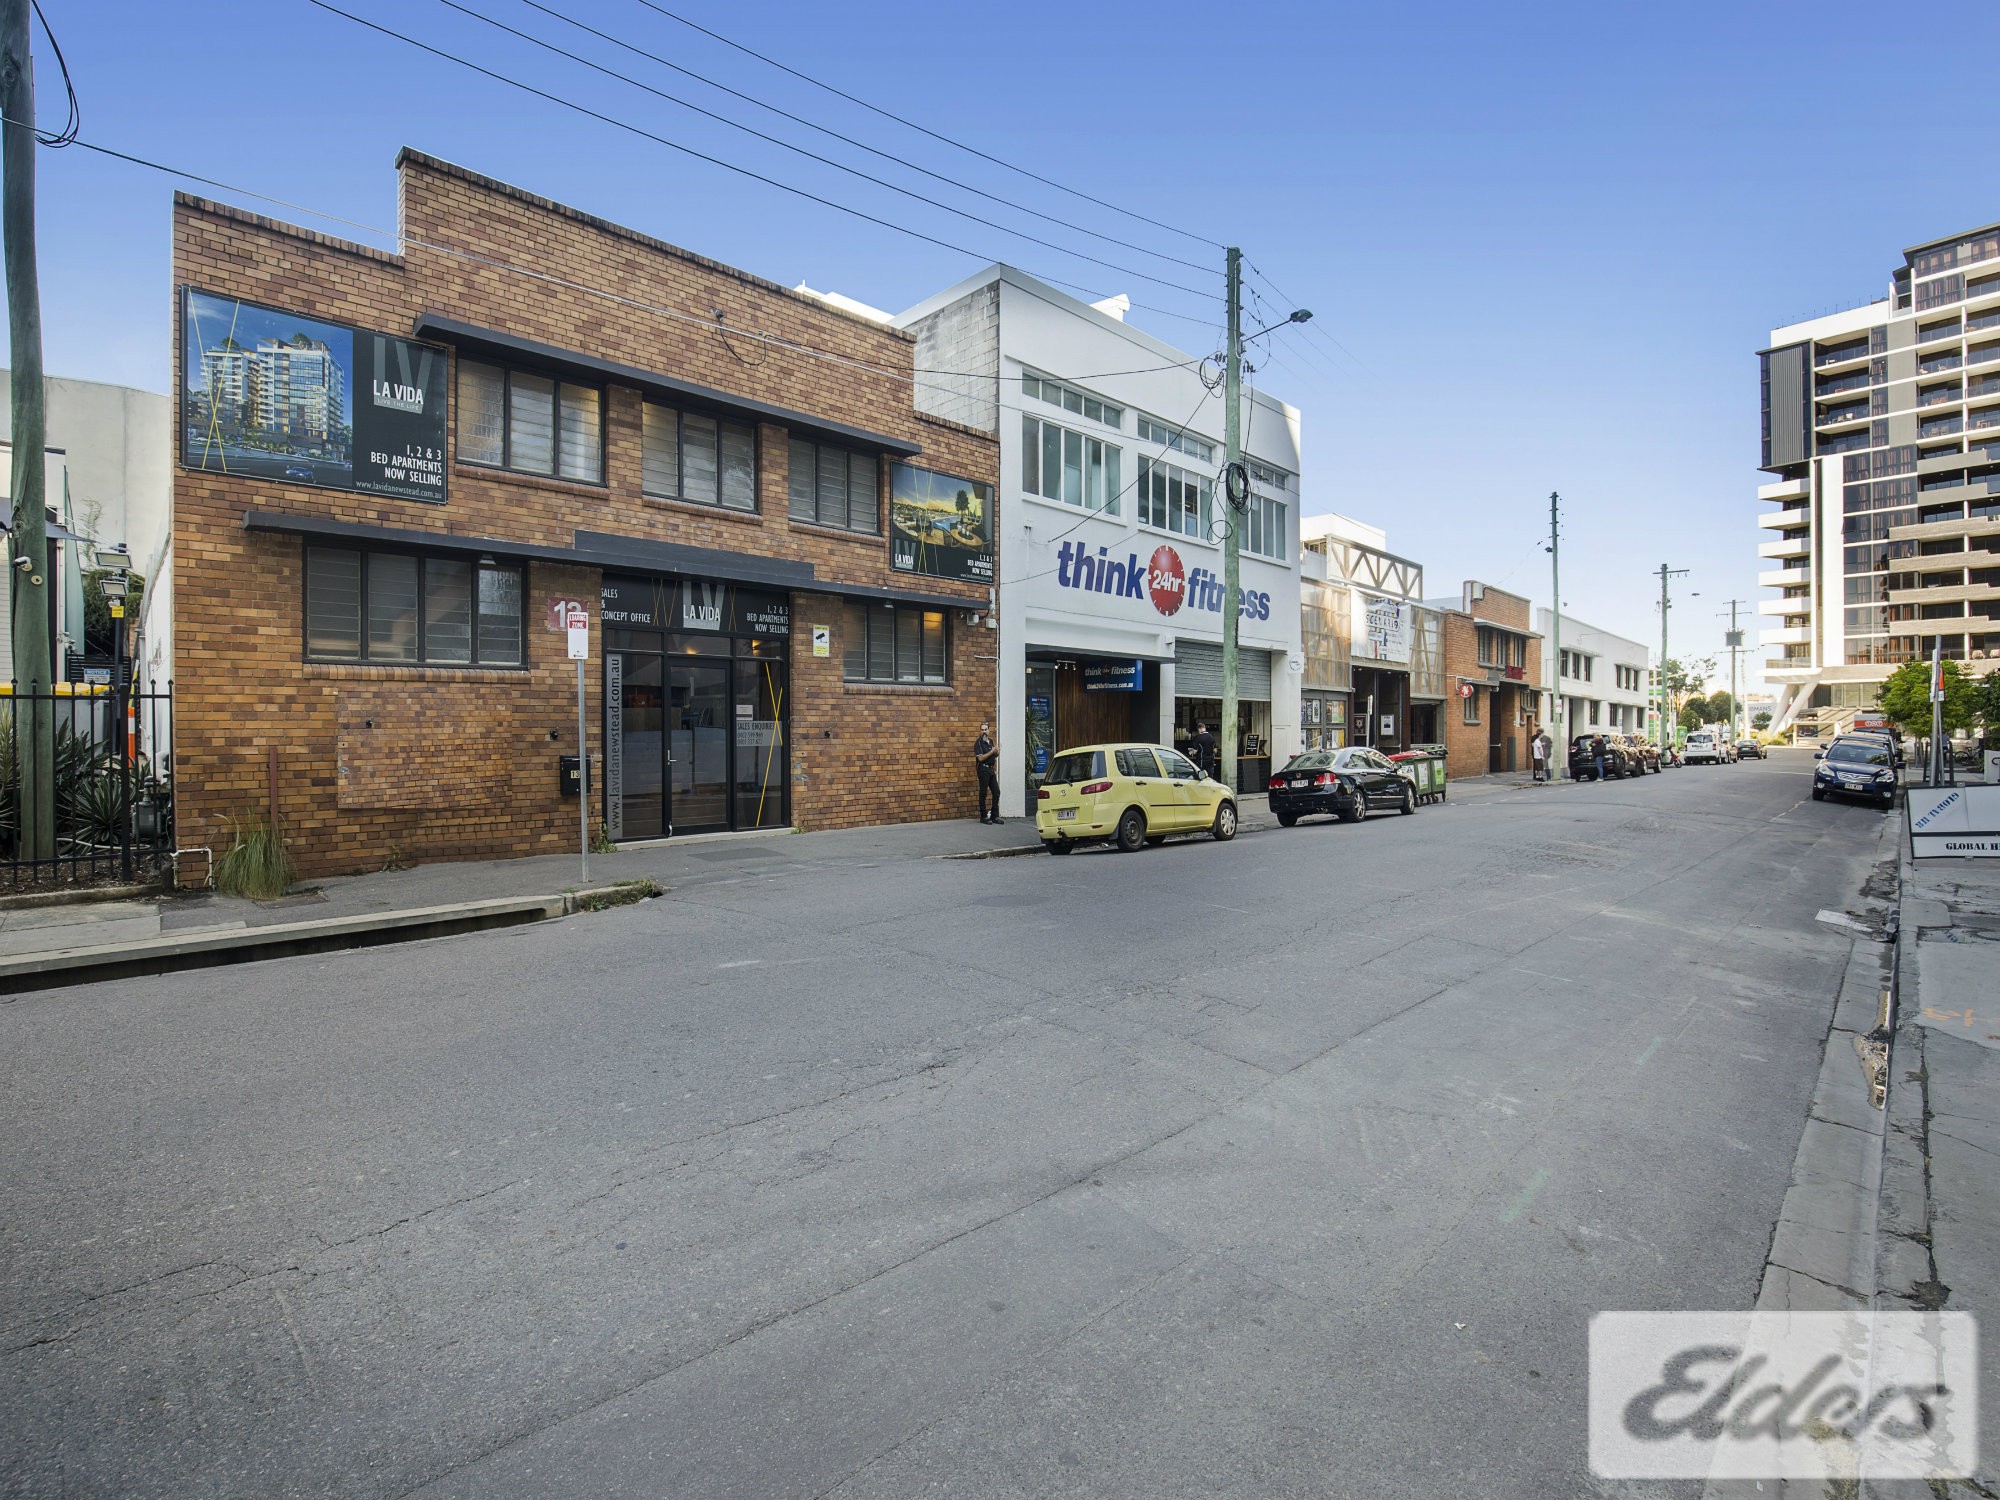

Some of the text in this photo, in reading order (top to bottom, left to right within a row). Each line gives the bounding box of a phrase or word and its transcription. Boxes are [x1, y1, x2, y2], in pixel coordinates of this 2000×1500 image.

[374, 380, 424, 404] LA VIDA
[417, 446, 422, 457] 2
[426, 448, 432, 459] &
[437, 450, 441, 460] 3
[371, 451, 441, 474] BED APARTMENTS
[384, 467, 441, 486] NOW SELLING
[356, 480, 442, 499] www.lavidanewstead.com.au
[895, 554, 914, 565] LA VIDA
[1058, 541, 1147, 599] think
[1152, 569, 1181, 593] 24hr
[601, 588, 618, 598] SALES
[601, 599, 605, 608] &
[683, 604, 720, 621] LA VIDA
[779, 606, 783, 614] &
[601, 610, 650, 623] CONCEPT OFFICE
[747, 612, 788, 624] BED APARTMENTS
[755, 624, 788, 634] NOW SELLING
[1085, 666, 1101, 676] think
[737, 722, 750, 730] SALES
[609, 658, 620, 830] www.lavidanewstead.com.au
[1990, 842, 2000, 850] H
